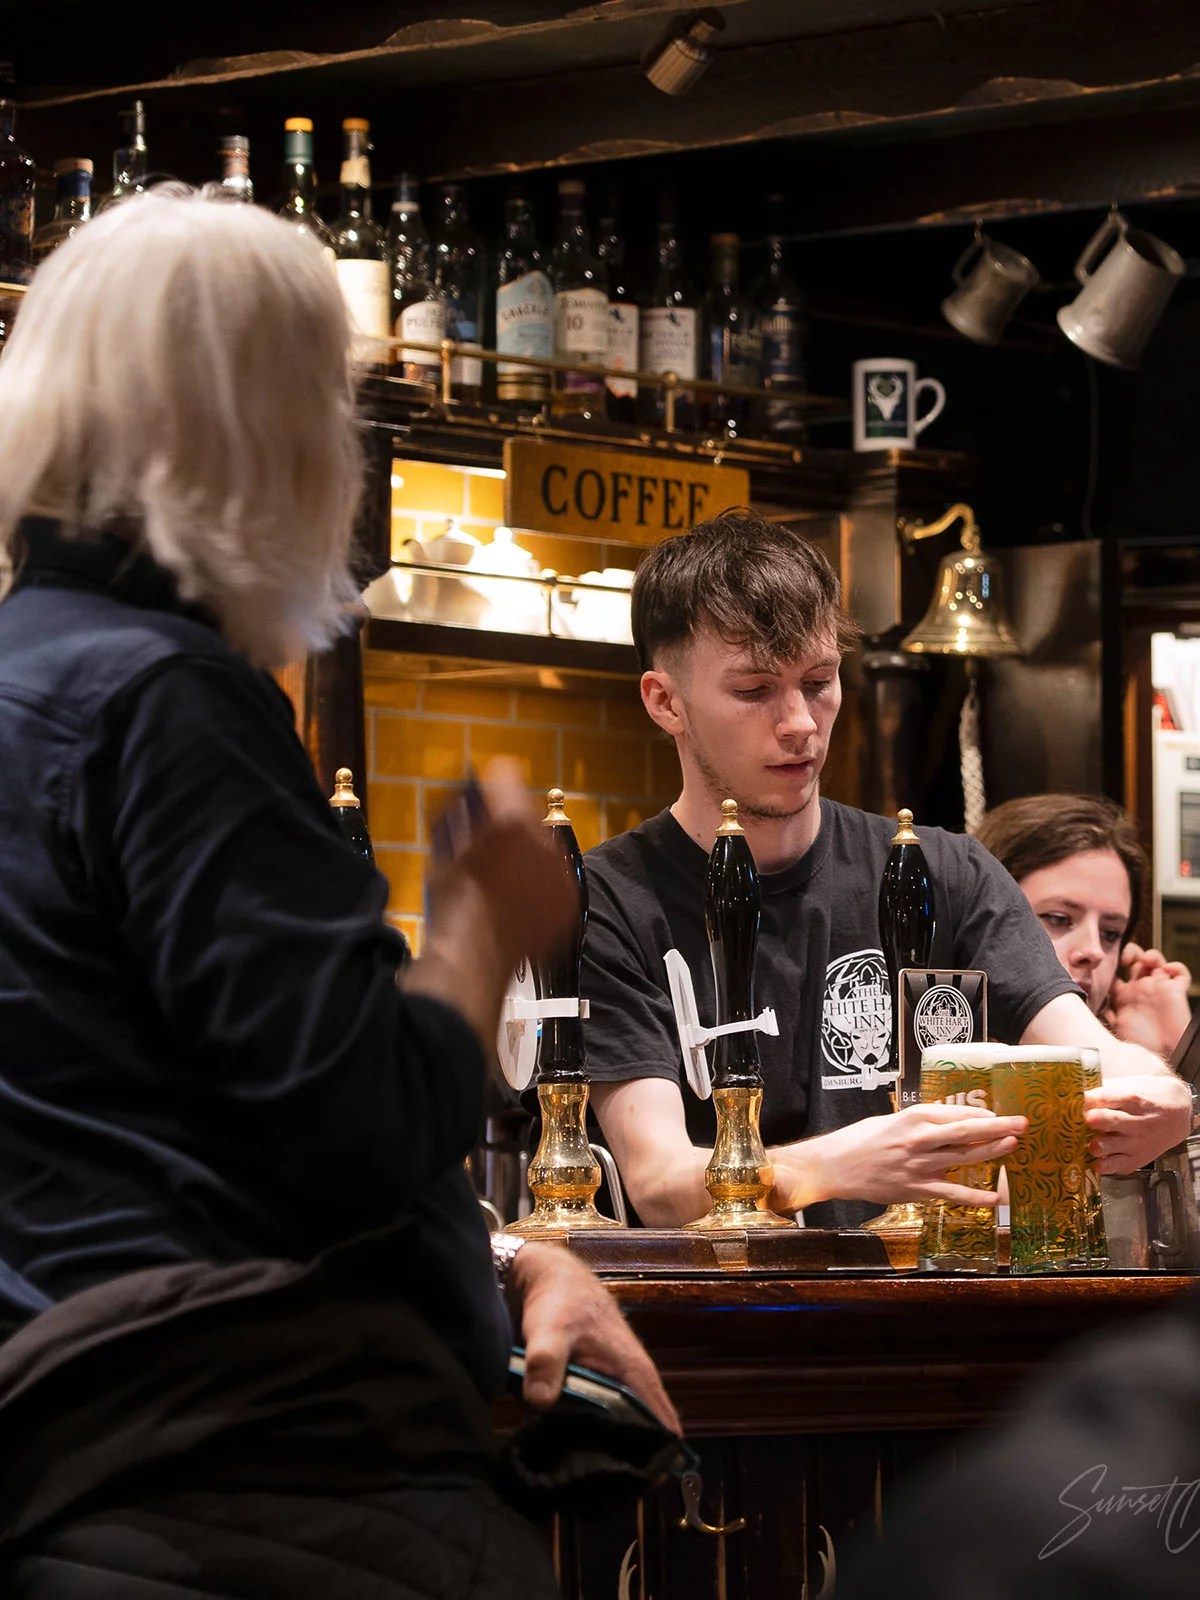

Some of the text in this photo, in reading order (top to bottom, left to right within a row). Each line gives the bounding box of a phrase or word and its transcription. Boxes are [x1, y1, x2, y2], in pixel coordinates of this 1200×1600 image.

[541, 463, 710, 531] COFFEE
[858, 986, 879, 998] THE
[854, 1013, 886, 1029] INN
[919, 1016, 968, 1026] WHITE HART
[936, 1026, 951, 1035] INN
